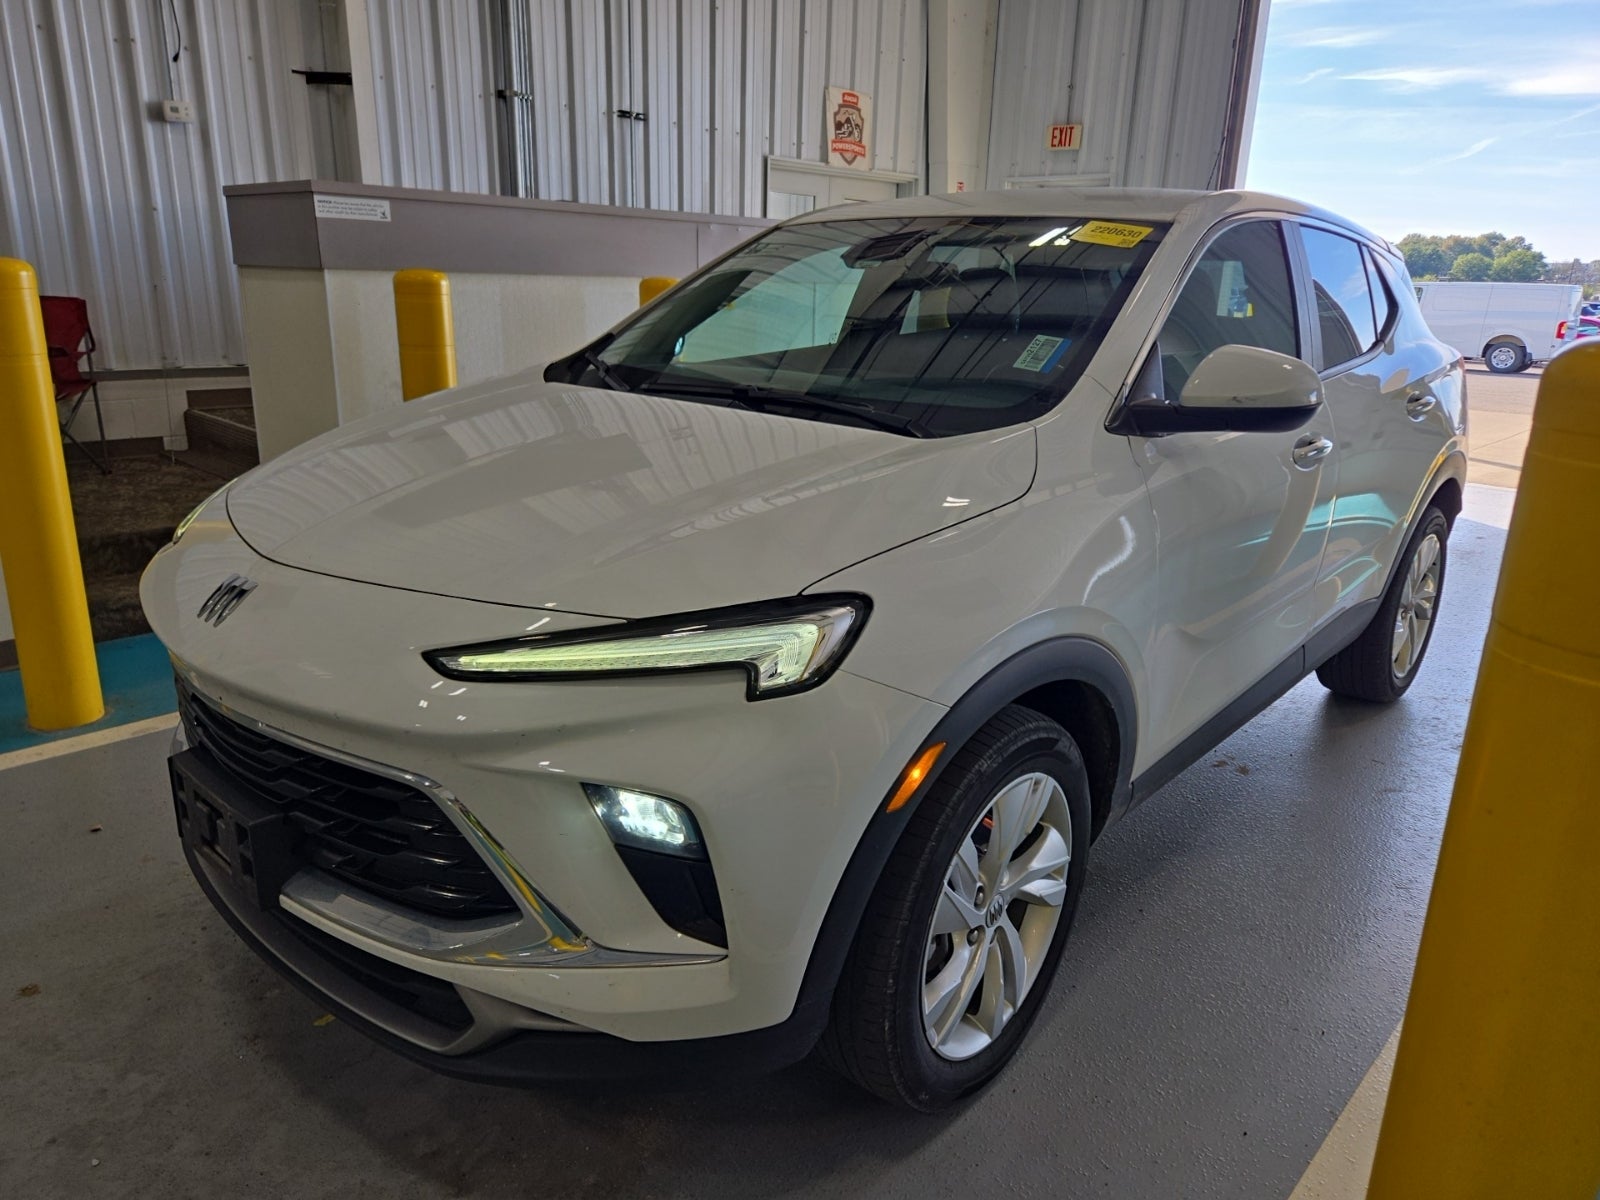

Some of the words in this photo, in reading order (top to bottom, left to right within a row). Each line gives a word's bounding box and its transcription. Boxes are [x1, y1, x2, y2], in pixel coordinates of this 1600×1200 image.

[1051, 126, 1075, 147] EXIT
[832, 142, 864, 155] POWERSPORTS
[1091, 226, 1142, 238] 220630
